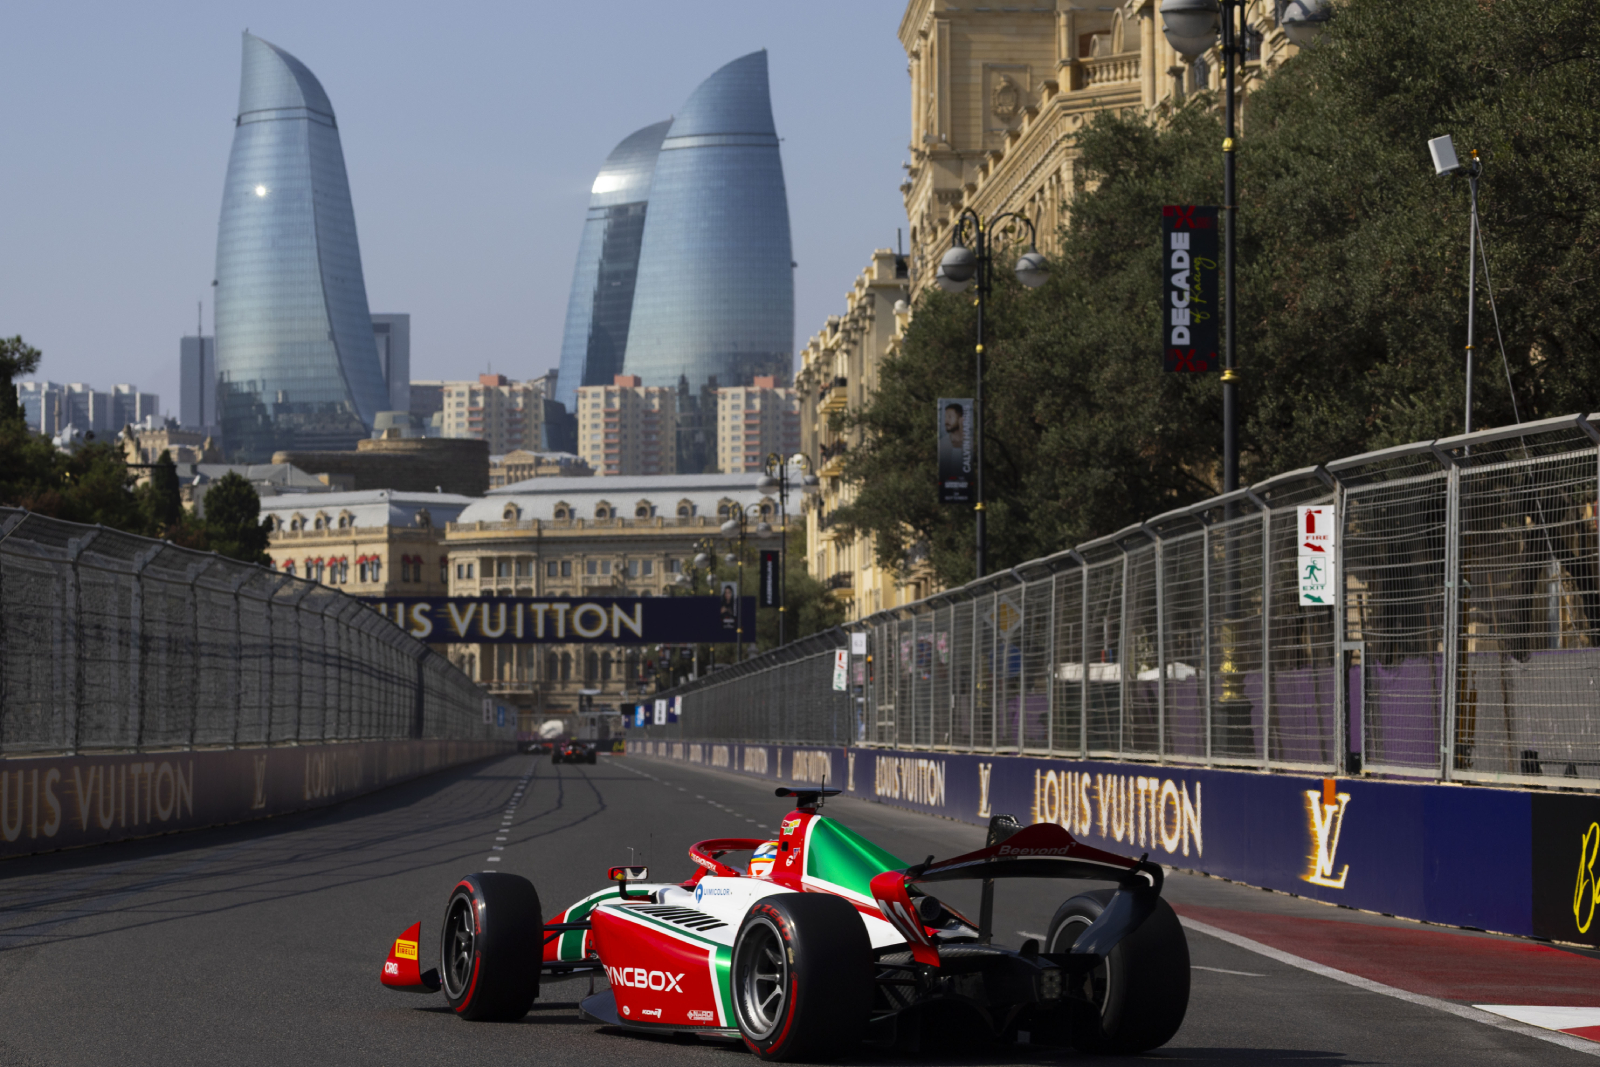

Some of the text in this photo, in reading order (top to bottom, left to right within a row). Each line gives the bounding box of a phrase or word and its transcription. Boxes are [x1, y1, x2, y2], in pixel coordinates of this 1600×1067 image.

[1171, 232, 1190, 345] DECADE
[1183, 254, 1216, 323] of Racing
[962, 440, 972, 473] CALVIN
[448, 603, 642, 638] VUITTON
[73, 760, 193, 832] VUITTON
[875, 755, 900, 800] LOUIS
[900, 757, 946, 807] VUITTON
[1035, 768, 1203, 858] LOUIS VUITTON
[998, 845, 1070, 856] Beeyond
[762, 904, 792, 941] ZERO
[397, 943, 416, 956] PIRELLI
